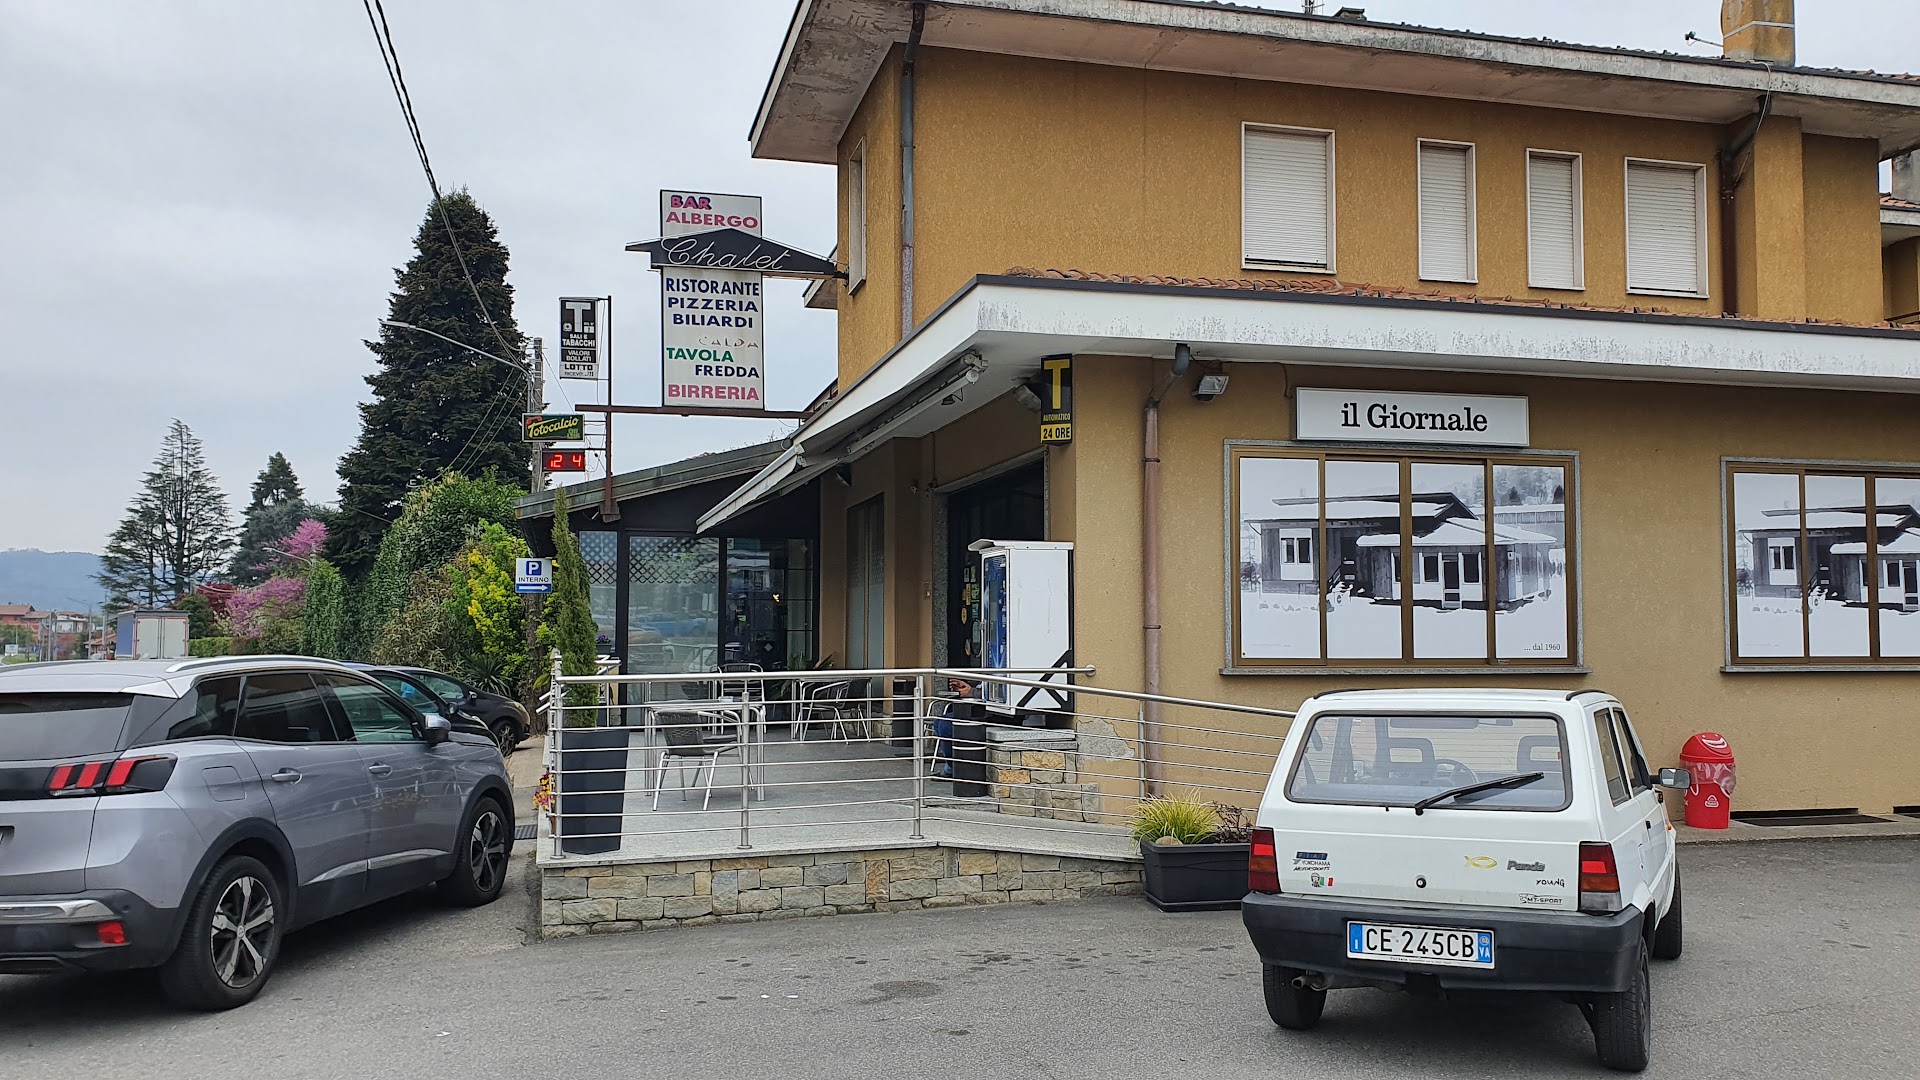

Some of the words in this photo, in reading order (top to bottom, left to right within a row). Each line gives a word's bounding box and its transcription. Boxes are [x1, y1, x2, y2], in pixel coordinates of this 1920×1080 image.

[670, 194, 712, 210] BAR
[665, 211, 758, 228] ALBERGO
[661, 237, 791, 269] Chalet
[666, 277, 760, 296] RISTORANTE
[668, 297, 759, 312] PIZZERIA
[565, 301, 591, 333] T
[673, 313, 753, 328] BILIARDI
[562, 338, 595, 347] TABACCHI
[666, 347, 734, 362] TAVOLA
[564, 363, 593, 371] LOTTO
[695, 364, 760, 378] FREDDA
[1043, 359, 1070, 409] T
[668, 384, 759, 400] BIRRERIA
[1043, 413, 1070, 422] AUTOMATICO
[1341, 402, 1360, 427] il
[1367, 403, 1488, 432] Giornale
[528, 416, 579, 438] Totocalcio
[1043, 428, 1052, 439] 24
[1055, 427, 1070, 438] ORE
[528, 562, 539, 575] P
[1532, 643, 1543, 651] dal
[1545, 643, 1561, 651] 1960
[1507, 859, 1545, 871] Panda
[1536, 878, 1565, 888] YOUNG
[1479, 946, 1490, 957] VA
